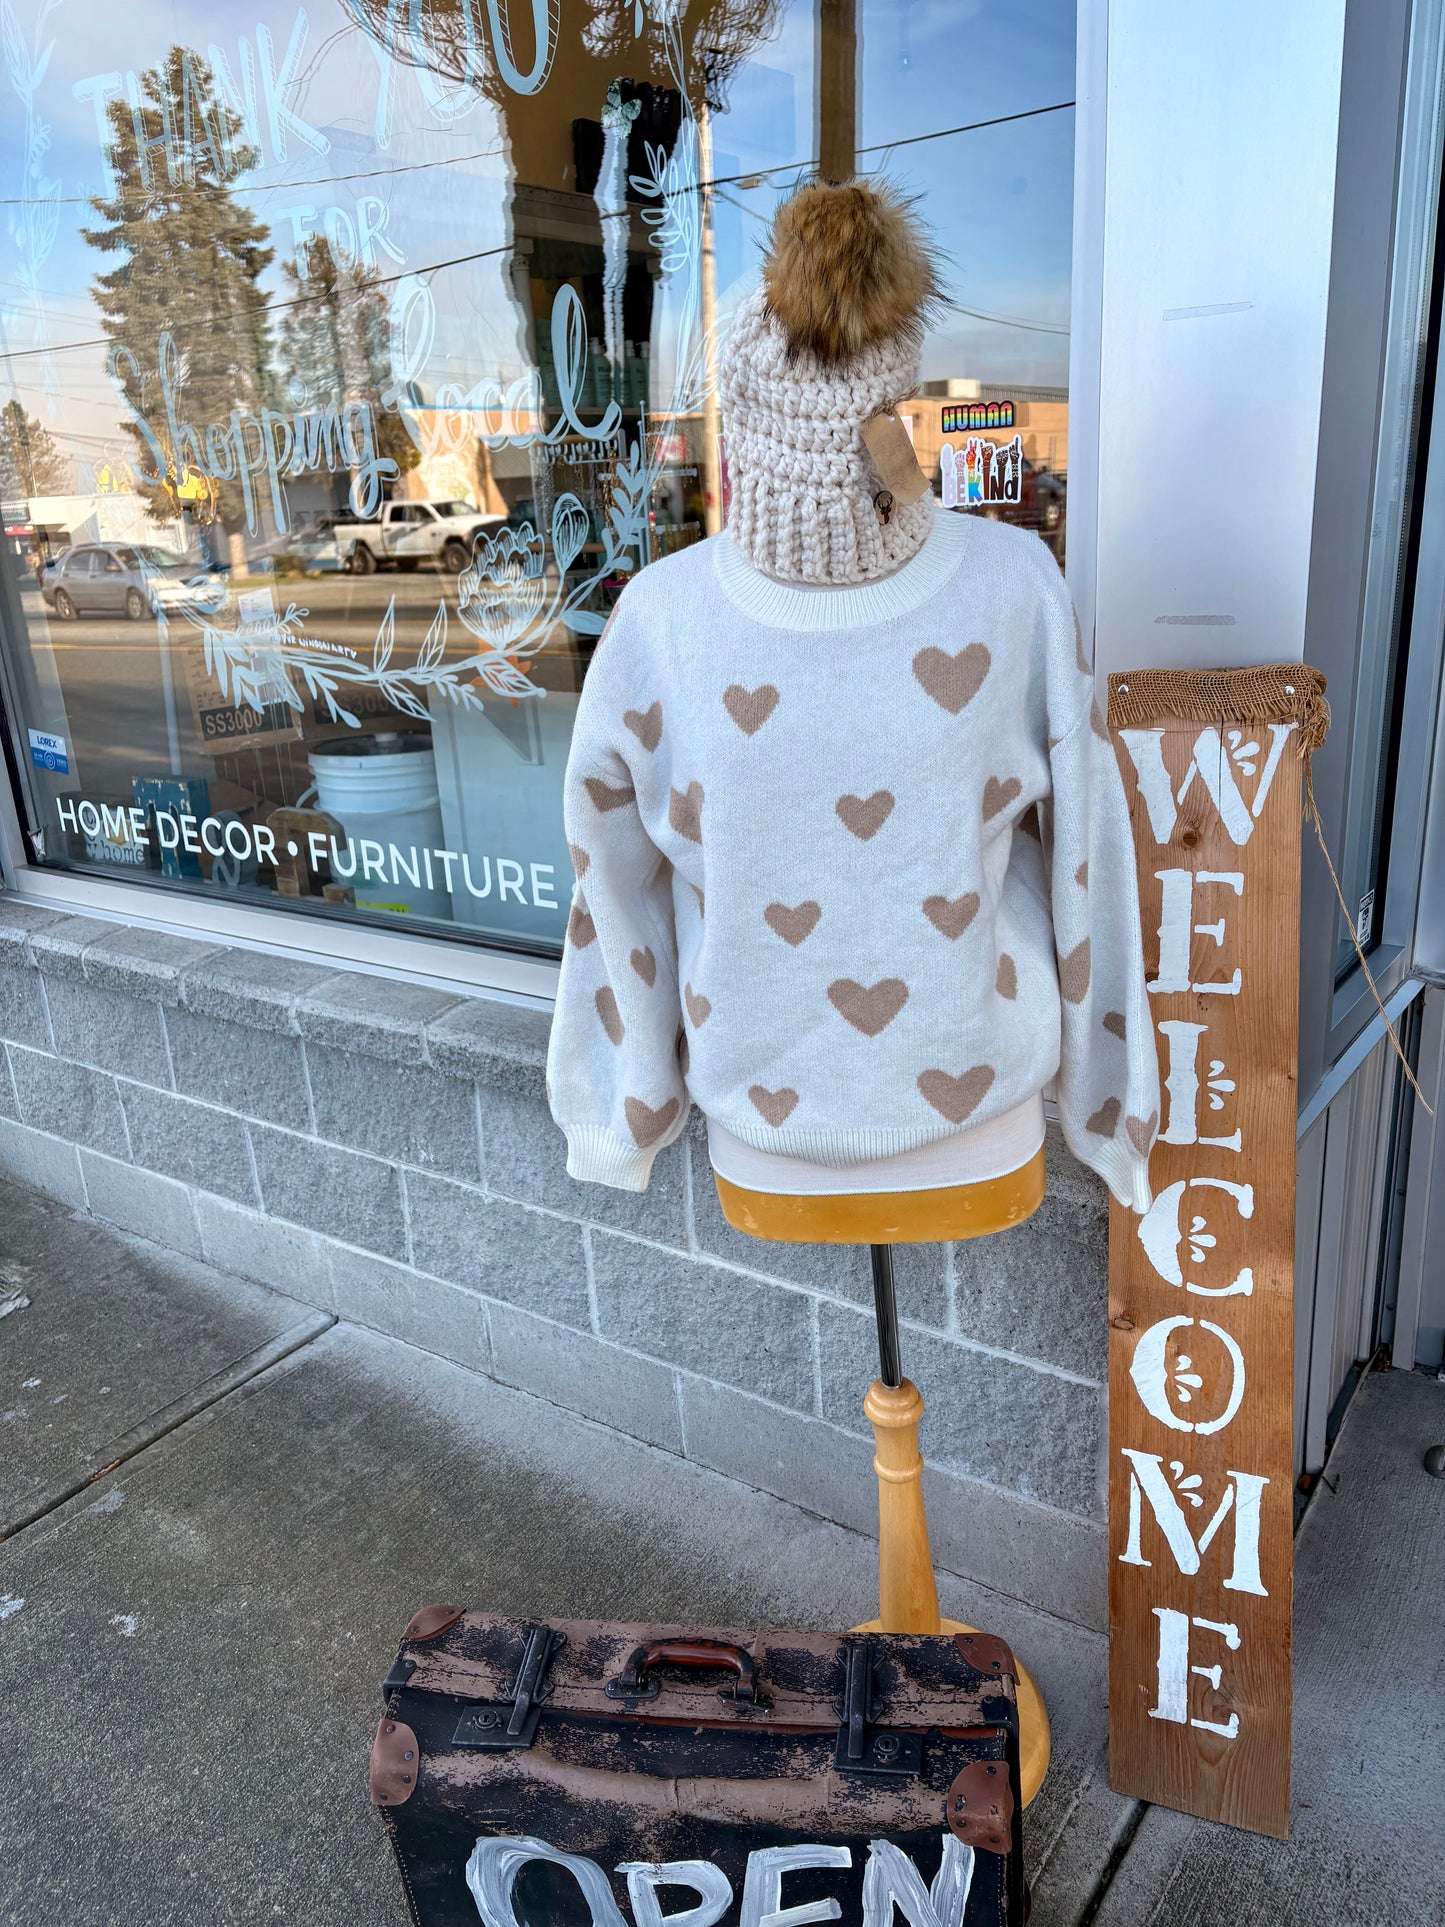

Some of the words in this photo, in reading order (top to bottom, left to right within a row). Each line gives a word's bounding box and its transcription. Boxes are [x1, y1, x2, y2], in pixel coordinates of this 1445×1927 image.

[72, 7, 331, 202] THANK
[275, 195, 408, 281] FOR
[107, 331, 400, 538] Shopping
[381, 271, 622, 457] local
[37, 735, 57, 749] LOREX
[205, 708, 262, 735] SS3000
[56, 797, 150, 845] HOME
[156, 811, 279, 866] DECOR
[308, 831, 559, 909] FURNITURE
[1118, 722, 1299, 1739] WELCOME
[466, 1833, 975, 1927] OPEN
